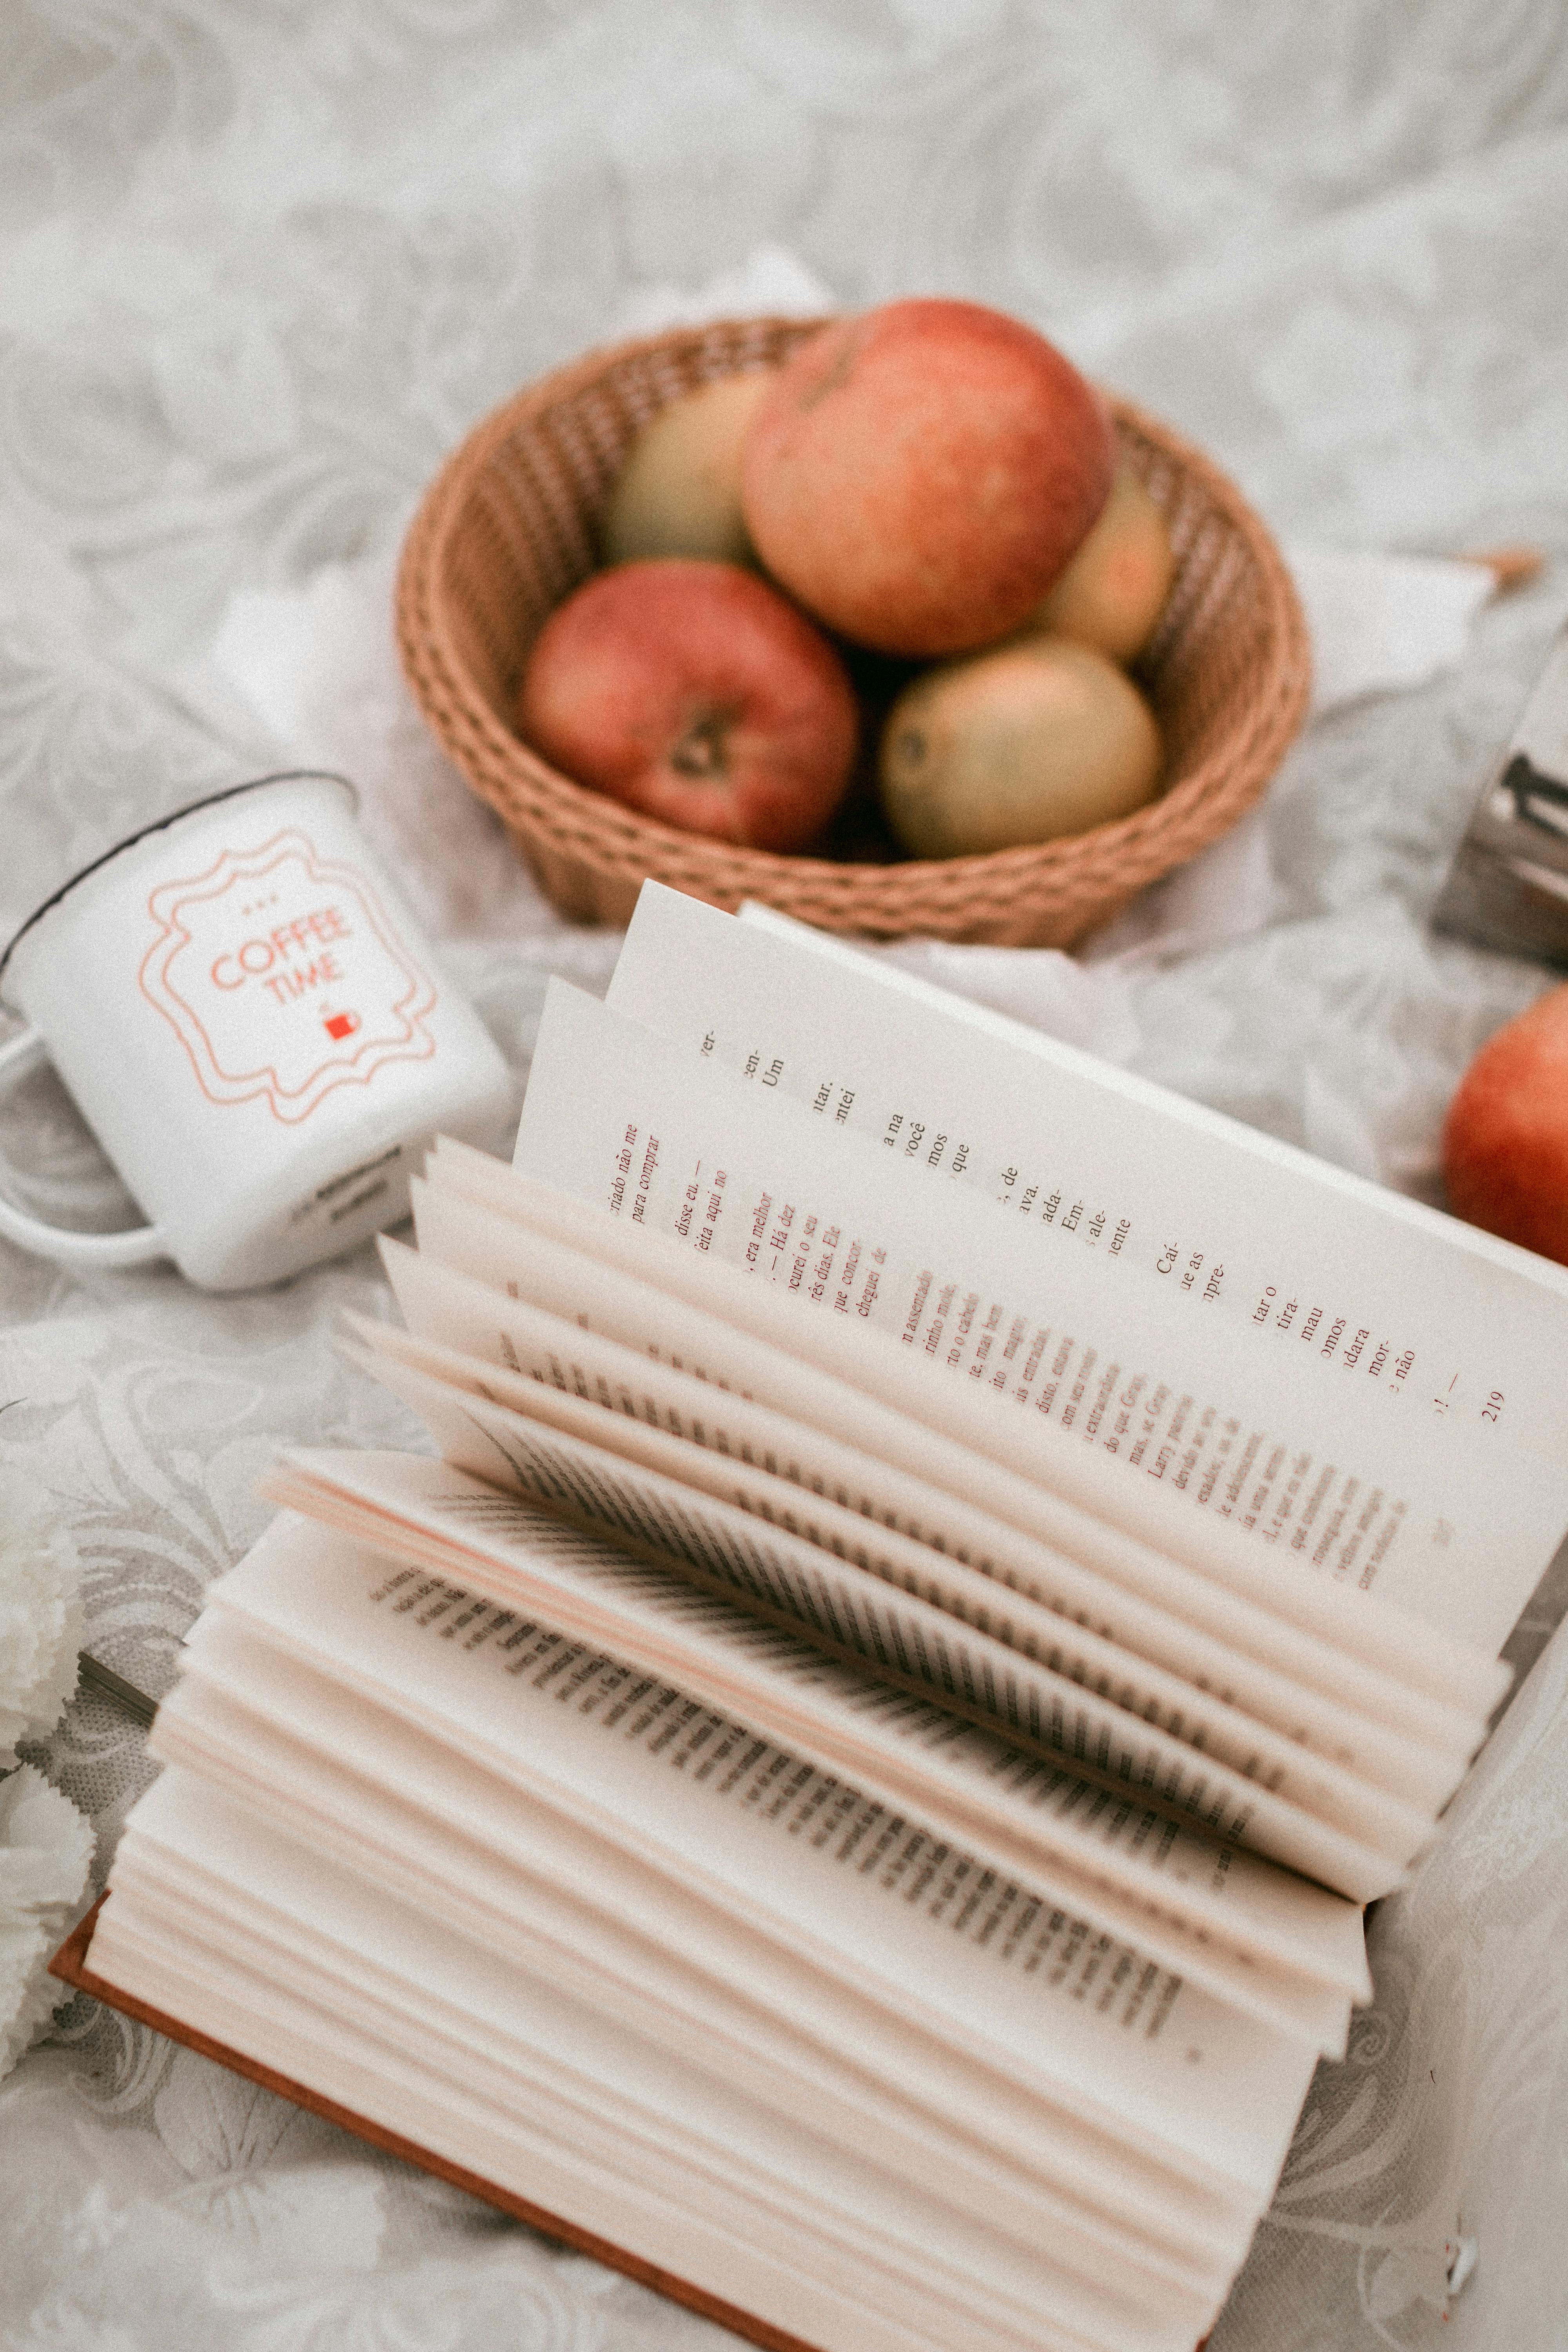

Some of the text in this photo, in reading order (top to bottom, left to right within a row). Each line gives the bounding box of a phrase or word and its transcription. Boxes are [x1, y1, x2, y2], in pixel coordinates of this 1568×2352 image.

[211, 906, 351, 991] COFFEE
[263, 952, 345, 1004] TIME
[762, 1059, 784, 1087] Um
[883, 1114, 904, 1147] a na
[615, 1148, 632, 1174] não
[624, 1124, 638, 1146] me
[951, 1144, 970, 1173] que
[632, 1134, 660, 1225] para comprar
[714, 1170, 728, 1189] no
[1001, 1167, 1018, 1187] de
[674, 1204, 693, 1237] disse
[685, 1183, 699, 1201] eu.
[706, 1191, 723, 1223] aqui
[752, 1192, 773, 1239] melhor
[777, 1204, 796, 1228] dez
[1042, 1189, 1062, 1223] ada-
[1060, 1200, 1084, 1232] Em-
[769, 1229, 789, 1251] Há
[803, 1215, 818, 1238] seu
[822, 1225, 841, 1249] Ele
[1088, 1210, 1106, 1238] ale-
[745, 1241, 760, 1263] era
[799, 1241, 811, 1252] o
[841, 1235, 862, 1286] concor-
[1156, 1242, 1179, 1274] Caí-
[1189, 1252, 1204, 1270] as
[813, 1252, 834, 1281] dias.
[855, 1247, 887, 1318] cheguei de
[905, 1270, 933, 1333] assentado
[1265, 1286, 1277, 1297] o
[958, 1293, 980, 1335] cabelo
[981, 1304, 1004, 1332] bem
[1276, 1298, 1299, 1330] tira-
[1300, 1307, 1323, 1342] mau
[954, 1336, 966, 1347] o
[975, 1334, 993, 1361] mas
[1368, 1341, 1390, 1377] mor-
[1394, 1350, 1416, 1380] não
[1481, 1391, 1504, 1423] 219
[1103, 1437, 1120, 1454] do
[1114, 1410, 1131, 1435] que
[1146, 1446, 1176, 1480] Larry
